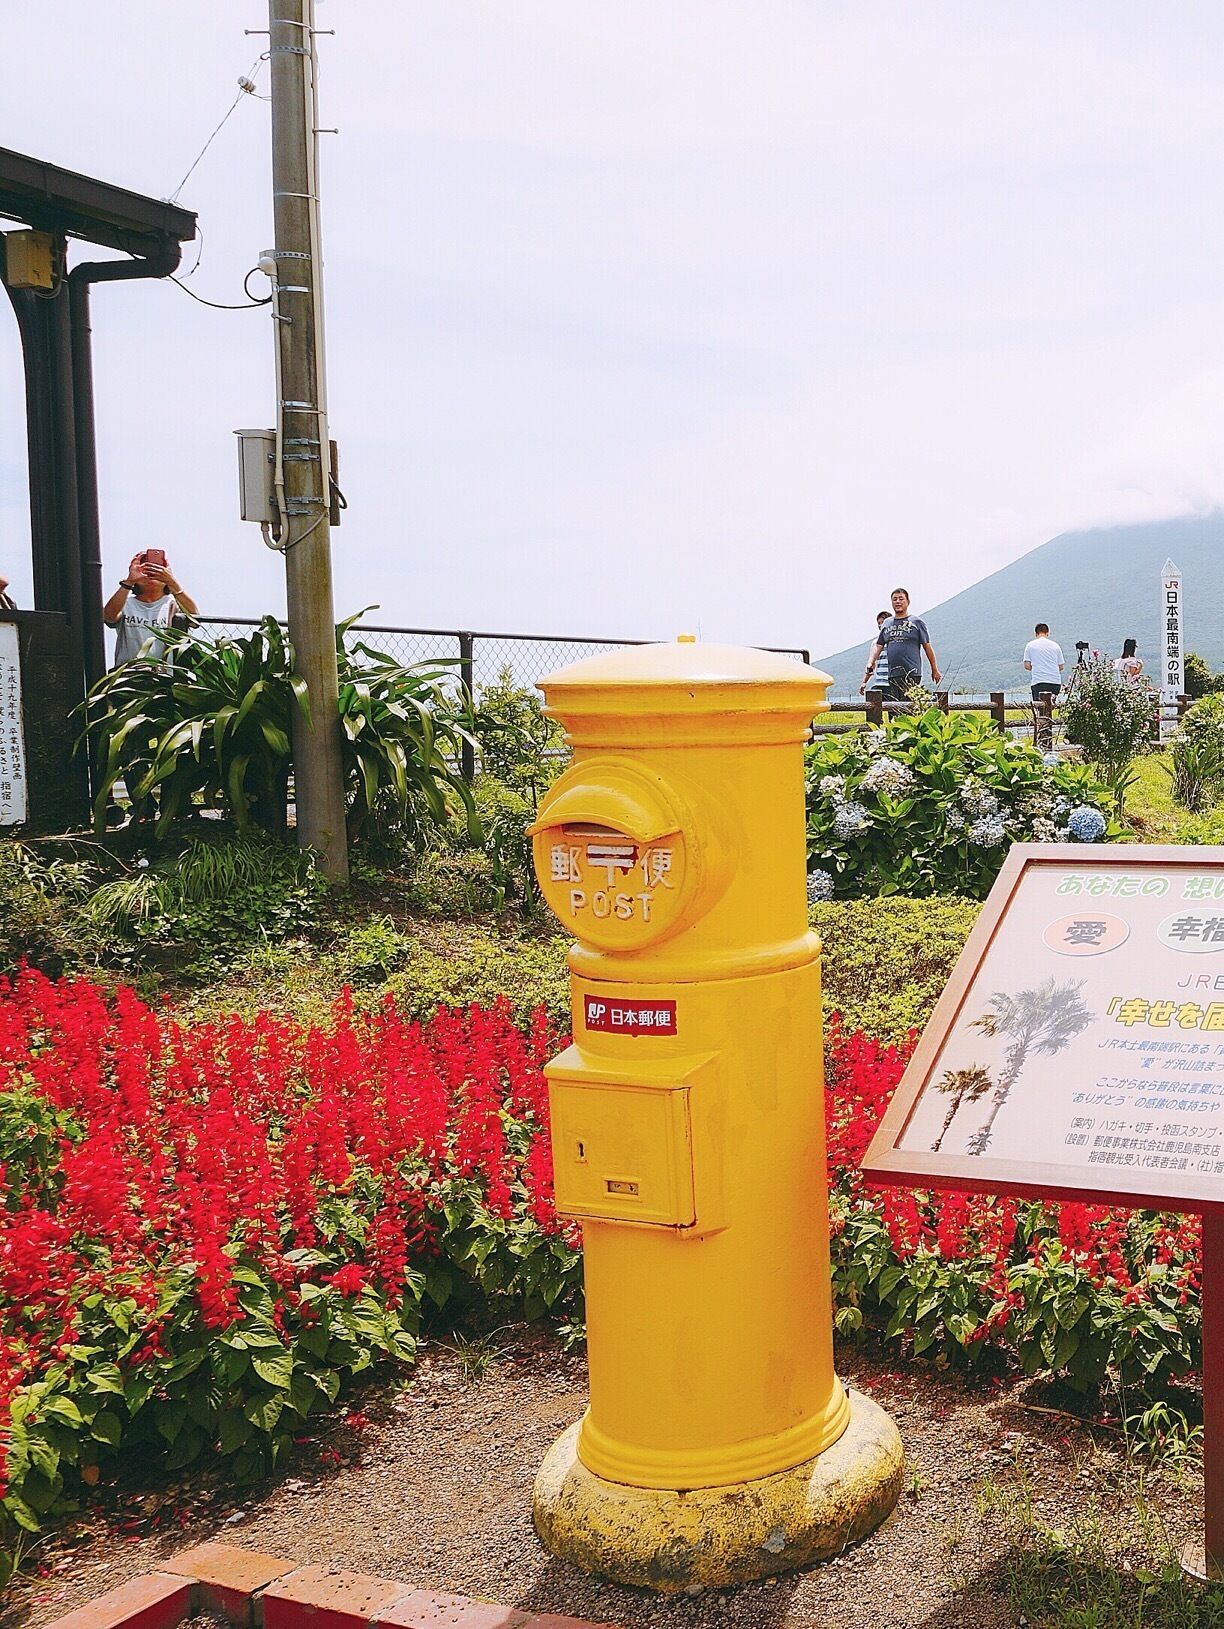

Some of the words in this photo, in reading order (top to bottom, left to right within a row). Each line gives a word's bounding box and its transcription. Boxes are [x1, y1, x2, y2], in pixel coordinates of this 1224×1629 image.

[1056, 874, 1170, 896] あなたの
[570, 889, 654, 922] POST
[1063, 920, 1108, 946] 愛
[610, 1008, 672, 1027] 日本郵便
